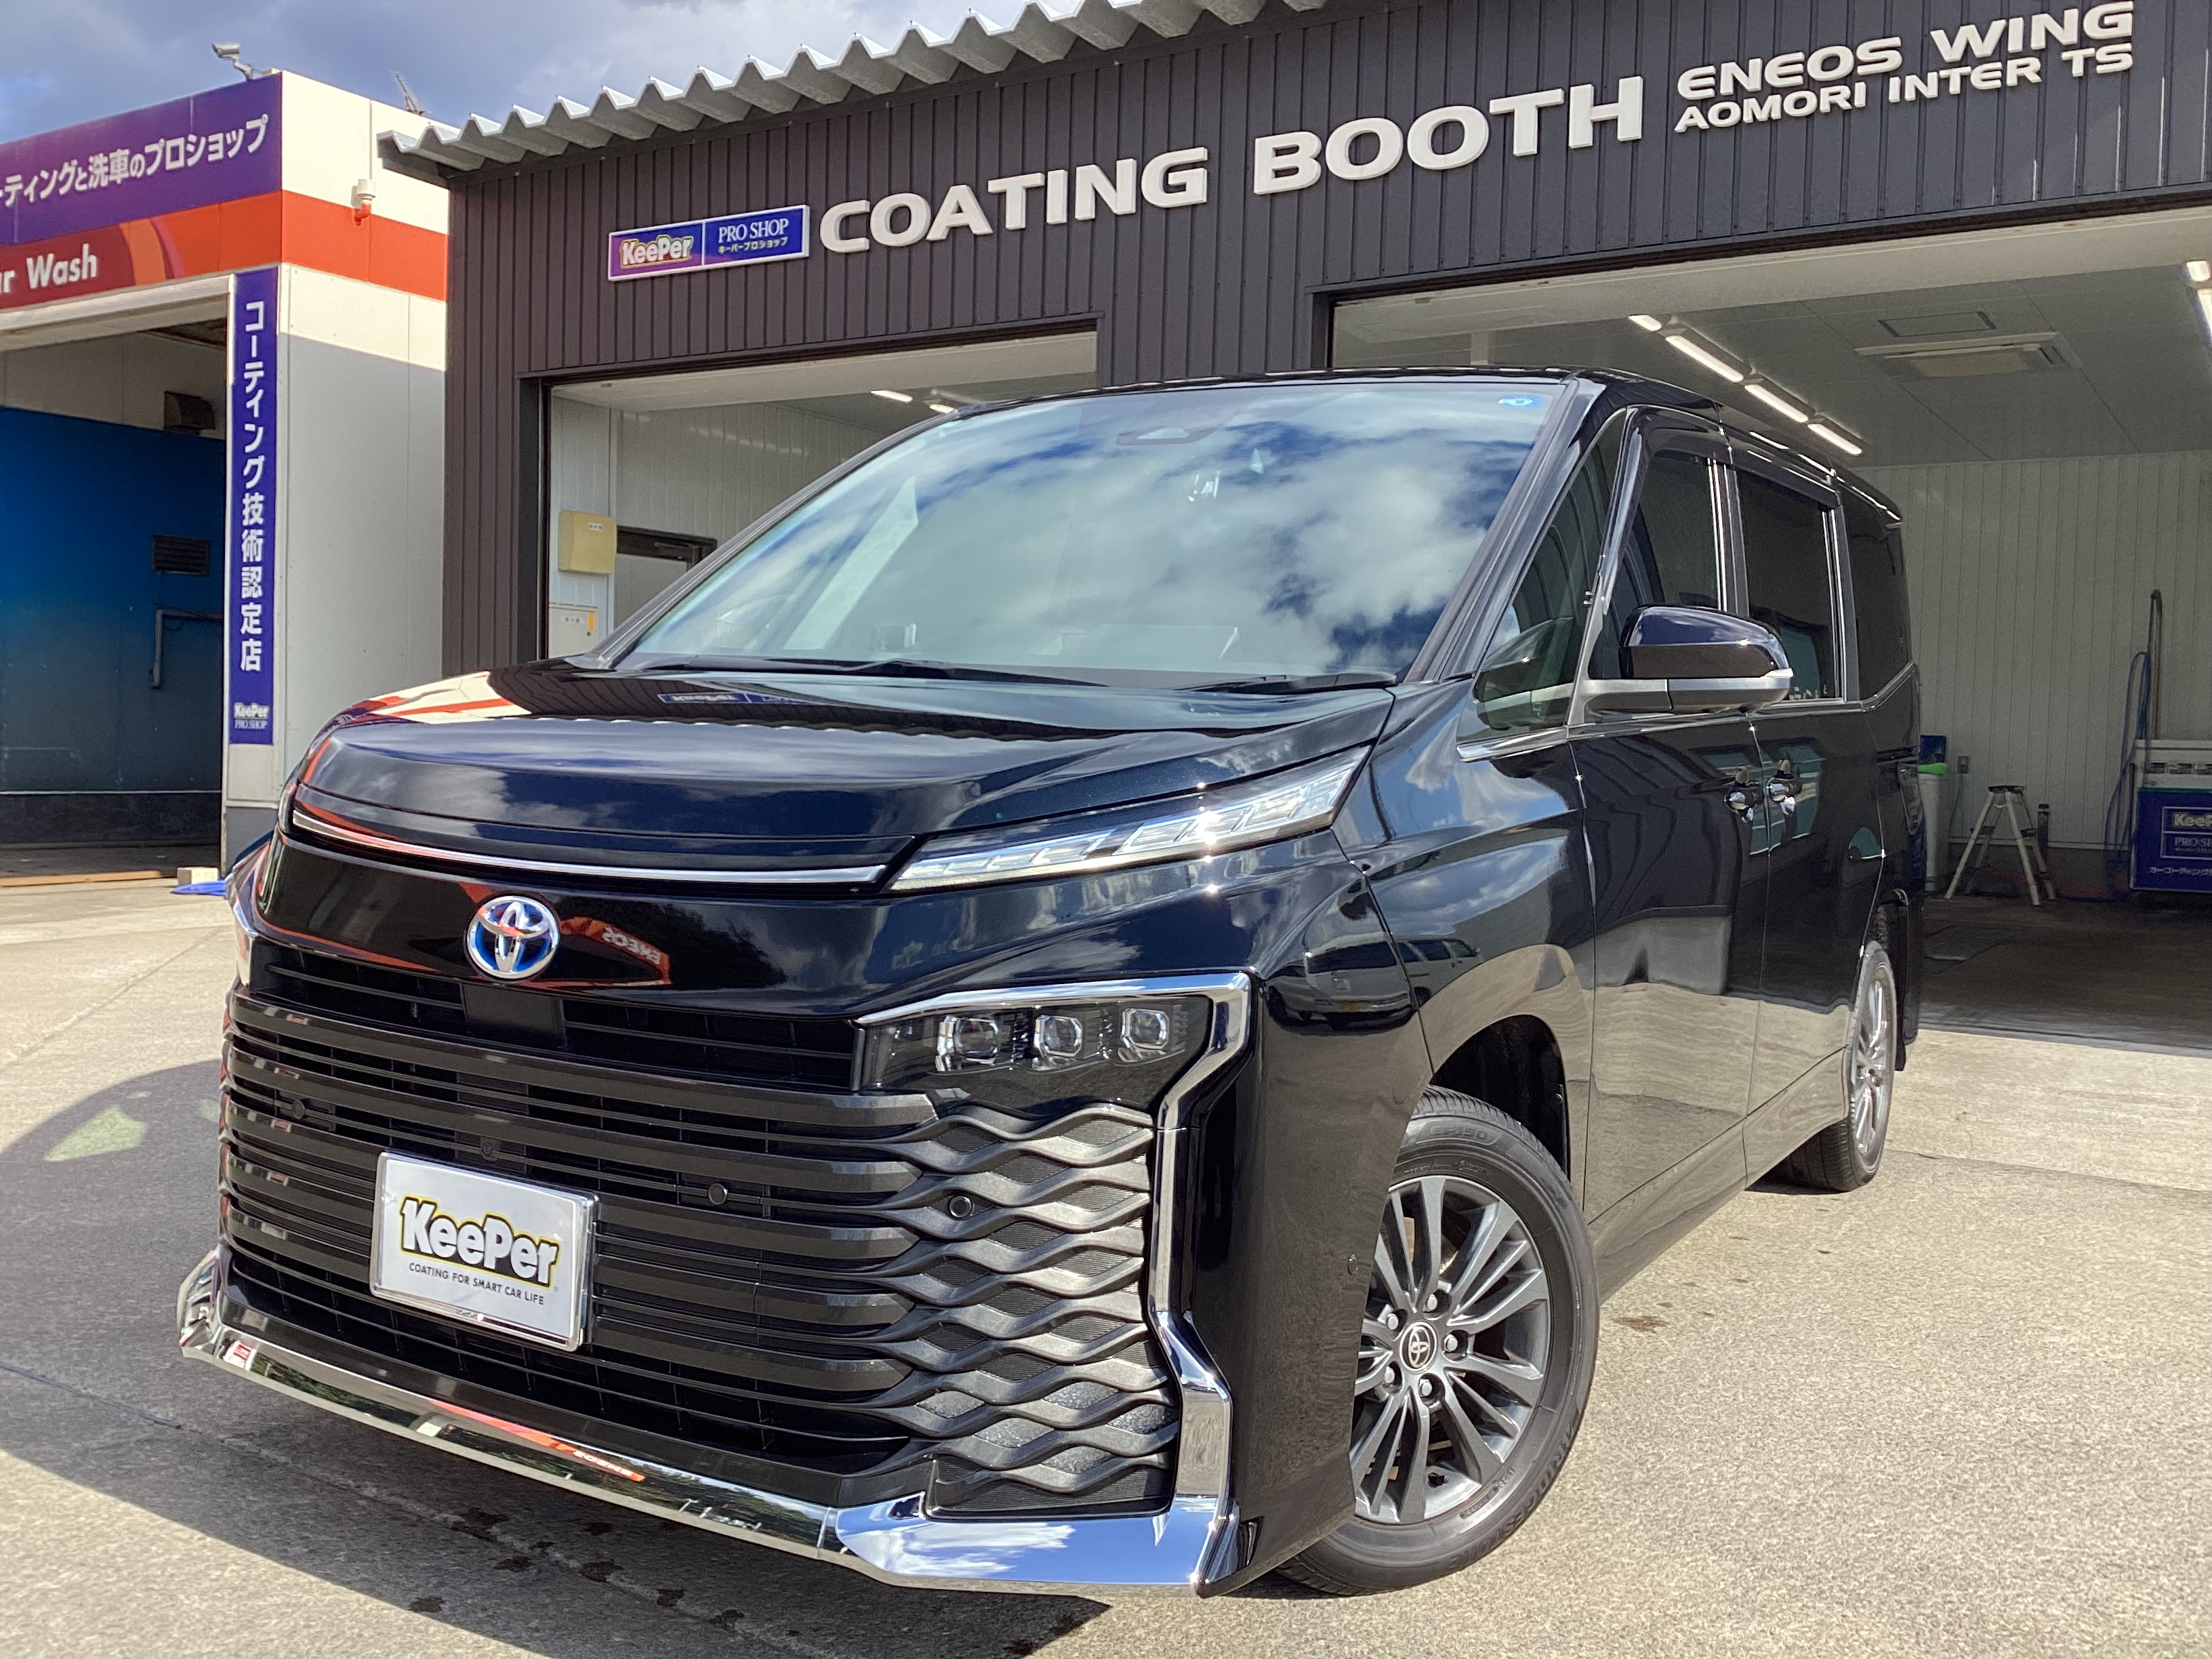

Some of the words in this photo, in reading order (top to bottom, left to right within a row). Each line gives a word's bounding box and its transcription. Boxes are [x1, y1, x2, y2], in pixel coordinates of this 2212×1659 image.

[1677, 36, 1903, 101] ENEOS
[1931, 1, 2135, 64] WING
[1675, 81, 1867, 134] AOMORI
[1889, 56, 2042, 103] INTER
[2061, 43, 2134, 77] TS
[0, 114, 269, 207] ティングと洗車のプロショップ
[819, 146, 1208, 253] COATING
[1253, 75, 1643, 194] BOOTH
[620, 234, 693, 268] KeePer
[718, 224, 747, 243] PRO
[750, 218, 790, 239] SHOP
[0, 270, 15, 293] r
[26, 243, 98, 289] Wash
[240, 301, 265, 672] コーティング技術認定店
[234, 703, 268, 719] KeePer
[234, 719, 249, 729] PRO
[249, 720, 267, 729] SHOP
[2175, 837, 2198, 847] PRO
[400, 1196, 561, 1289] KeePer
[409, 1263, 449, 1279] COATING
[452, 1273, 470, 1285] FOR
[473, 1278, 502, 1293] SMART
[504, 1286, 521, 1298] CAR
[525, 1291, 544, 1305] LIFE
